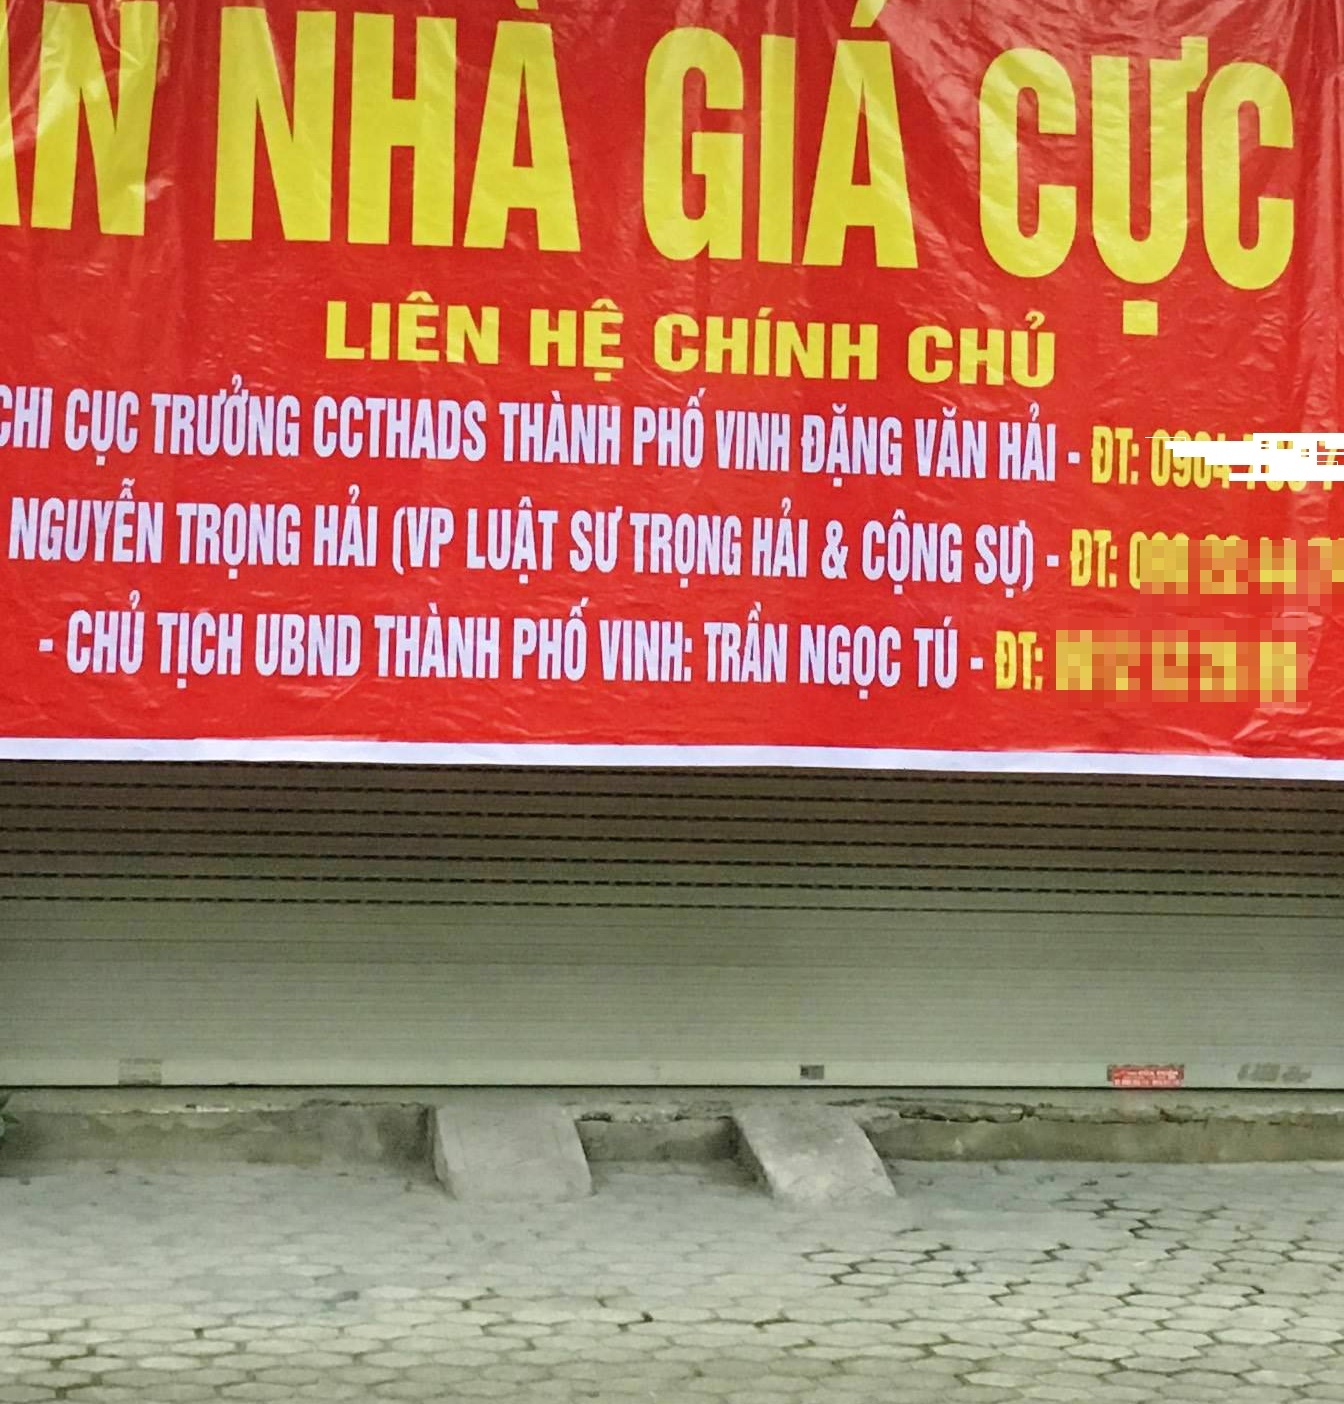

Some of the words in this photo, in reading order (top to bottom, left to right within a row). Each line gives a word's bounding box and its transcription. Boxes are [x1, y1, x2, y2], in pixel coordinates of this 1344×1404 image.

[977, 35, 1296, 337] CỰC
[325, 290, 500, 367] LIÊN
[528, 298, 624, 382] HỆ
[654, 304, 879, 383] CHÍNH
[908, 310, 1055, 390] CHỦ
[64, 387, 139, 467] CỤC
[151, 372, 300, 458] TRƯỞNG
[312, 395, 487, 463] CCTHADS
[498, 389, 621, 467] THÀNH
[632, 386, 705, 470] PHỐ
[715, 409, 791, 473] VINH
[799, 402, 902, 488] ĐẶNG
[915, 406, 988, 479] VĂN
[999, 403, 1056, 483] HẢI
[1091, 425, 1139, 486] ĐT:
[7, 476, 164, 565] NGUYỄN
[175, 502, 302, 581] TRỌNG
[312, 483, 378, 568] HẢI
[392, 504, 455, 576] (VP
[466, 495, 559, 584] LUẬT
[568, 504, 624, 574] SƯ
[629, 511, 743, 588] TRỌNG
[751, 495, 808, 579] HẢI
[821, 520, 849, 580] &
[862, 507, 963, 595] CỘNG
[1069, 528, 1118, 588] ĐT:
[65, 588, 146, 675] CHỦ
[156, 612, 244, 690] TỊCH
[254, 613, 362, 677] UBND
[373, 599, 501, 680] THÀNH
[512, 594, 588, 682] PHỐ
[598, 619, 693, 683] VINH:
[703, 598, 789, 685] TRẦN
[799, 624, 902, 700] NGỌC
[912, 614, 958, 689] TÚ
[994, 629, 1044, 691] ĐT:
